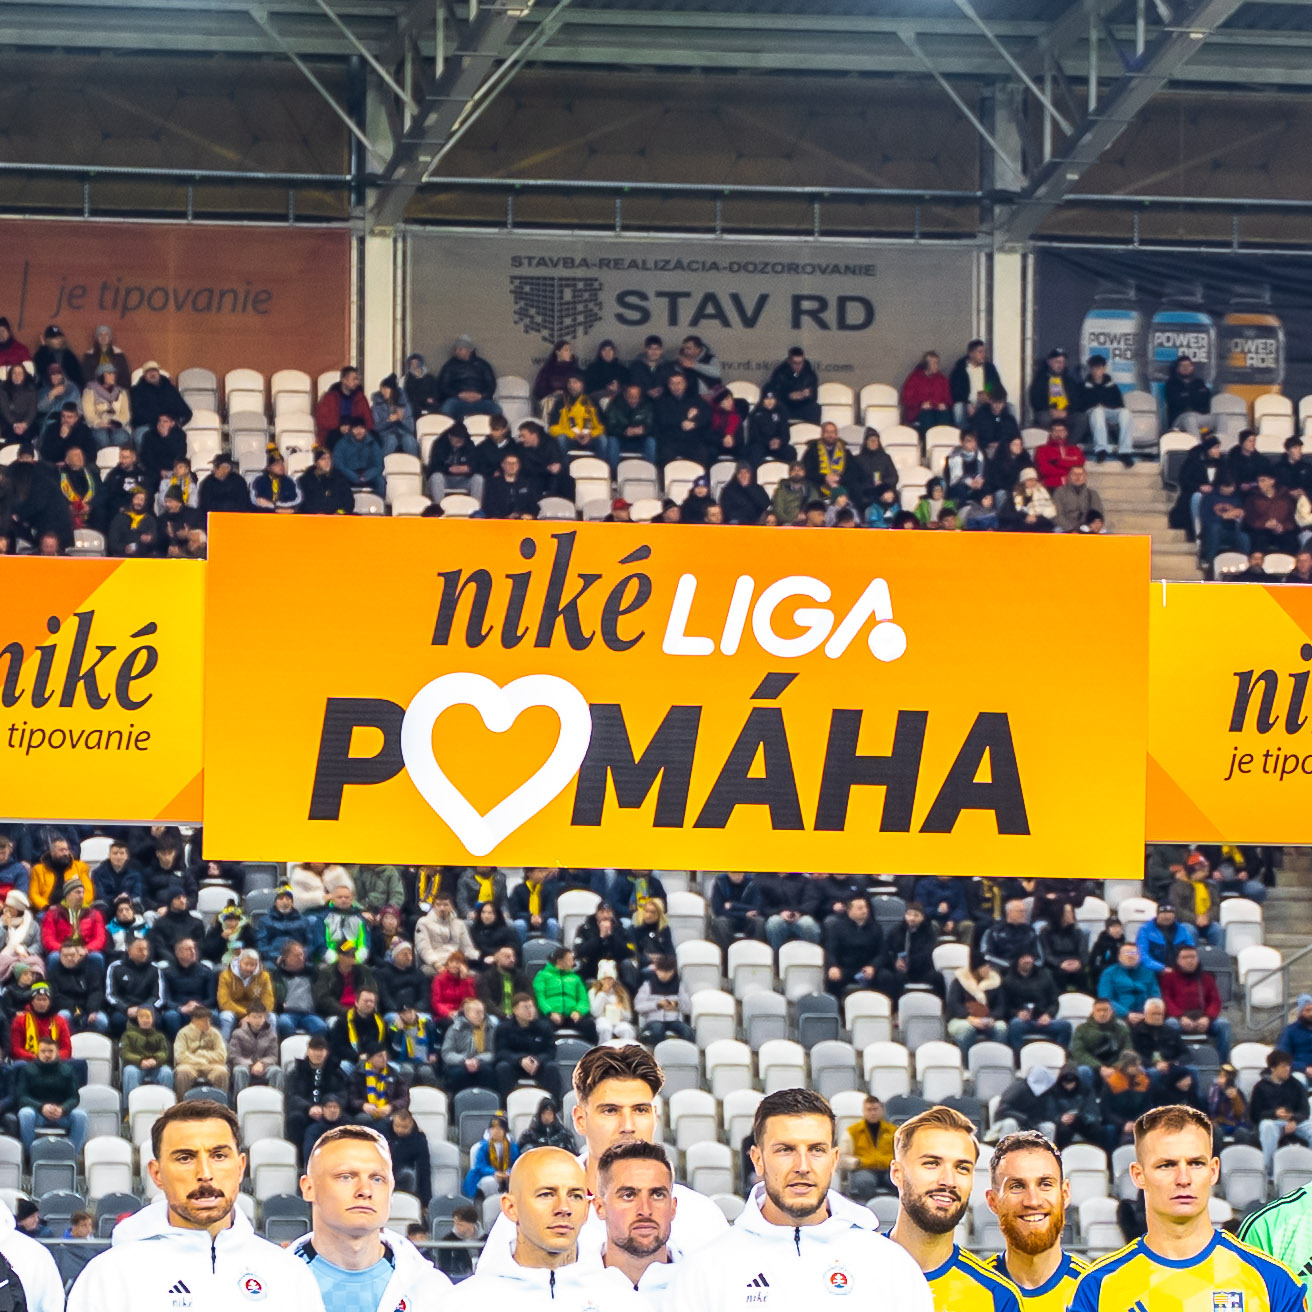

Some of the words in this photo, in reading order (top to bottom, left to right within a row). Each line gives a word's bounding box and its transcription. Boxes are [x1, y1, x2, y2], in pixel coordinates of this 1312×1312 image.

[51, 275, 89, 319] je
[97, 277, 274, 318] tipovanie
[613, 289, 770, 330] STAV
[790, 294, 877, 332] RD
[1153, 332, 1209, 347] POWER
[430, 530, 654, 653] niké
[661, 571, 908, 664] LIGA
[7, 719, 152, 755] tipovanie
[1223, 748, 1254, 782] je
